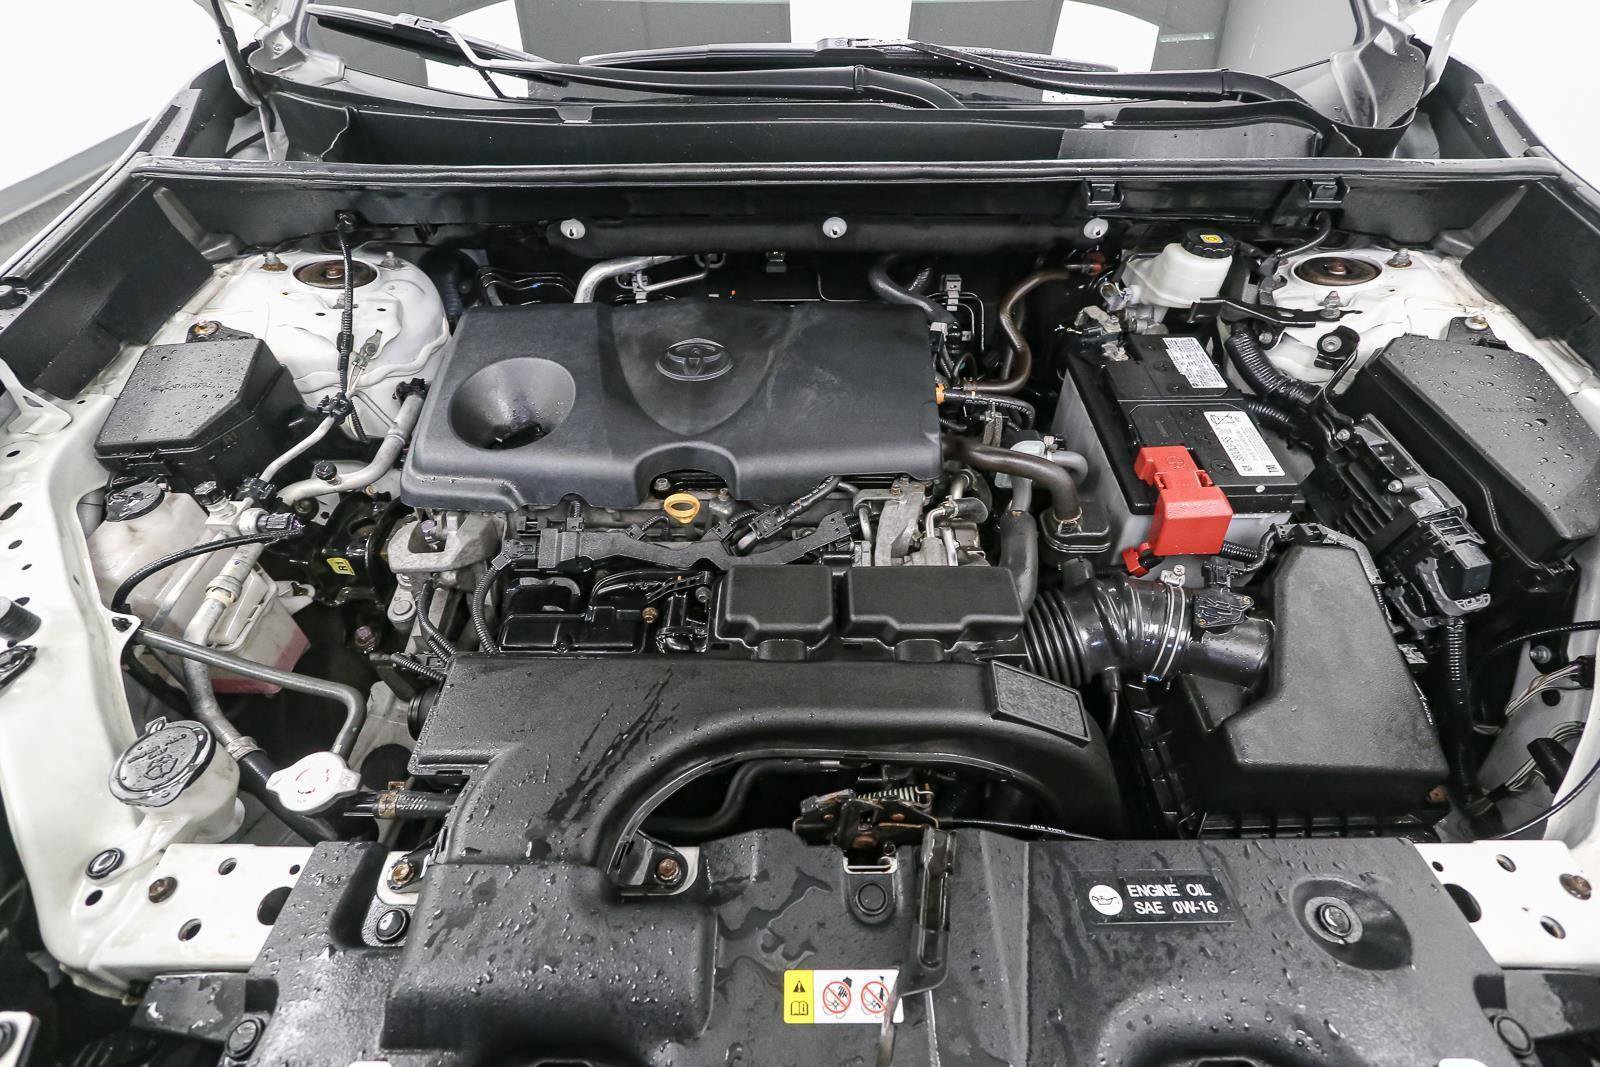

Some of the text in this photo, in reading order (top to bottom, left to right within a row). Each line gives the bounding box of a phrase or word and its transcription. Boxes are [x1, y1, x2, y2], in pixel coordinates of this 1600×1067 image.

[1126, 883, 1212, 898] ENGINE OIL
[1133, 900, 1219, 915] SAE 0W-16
